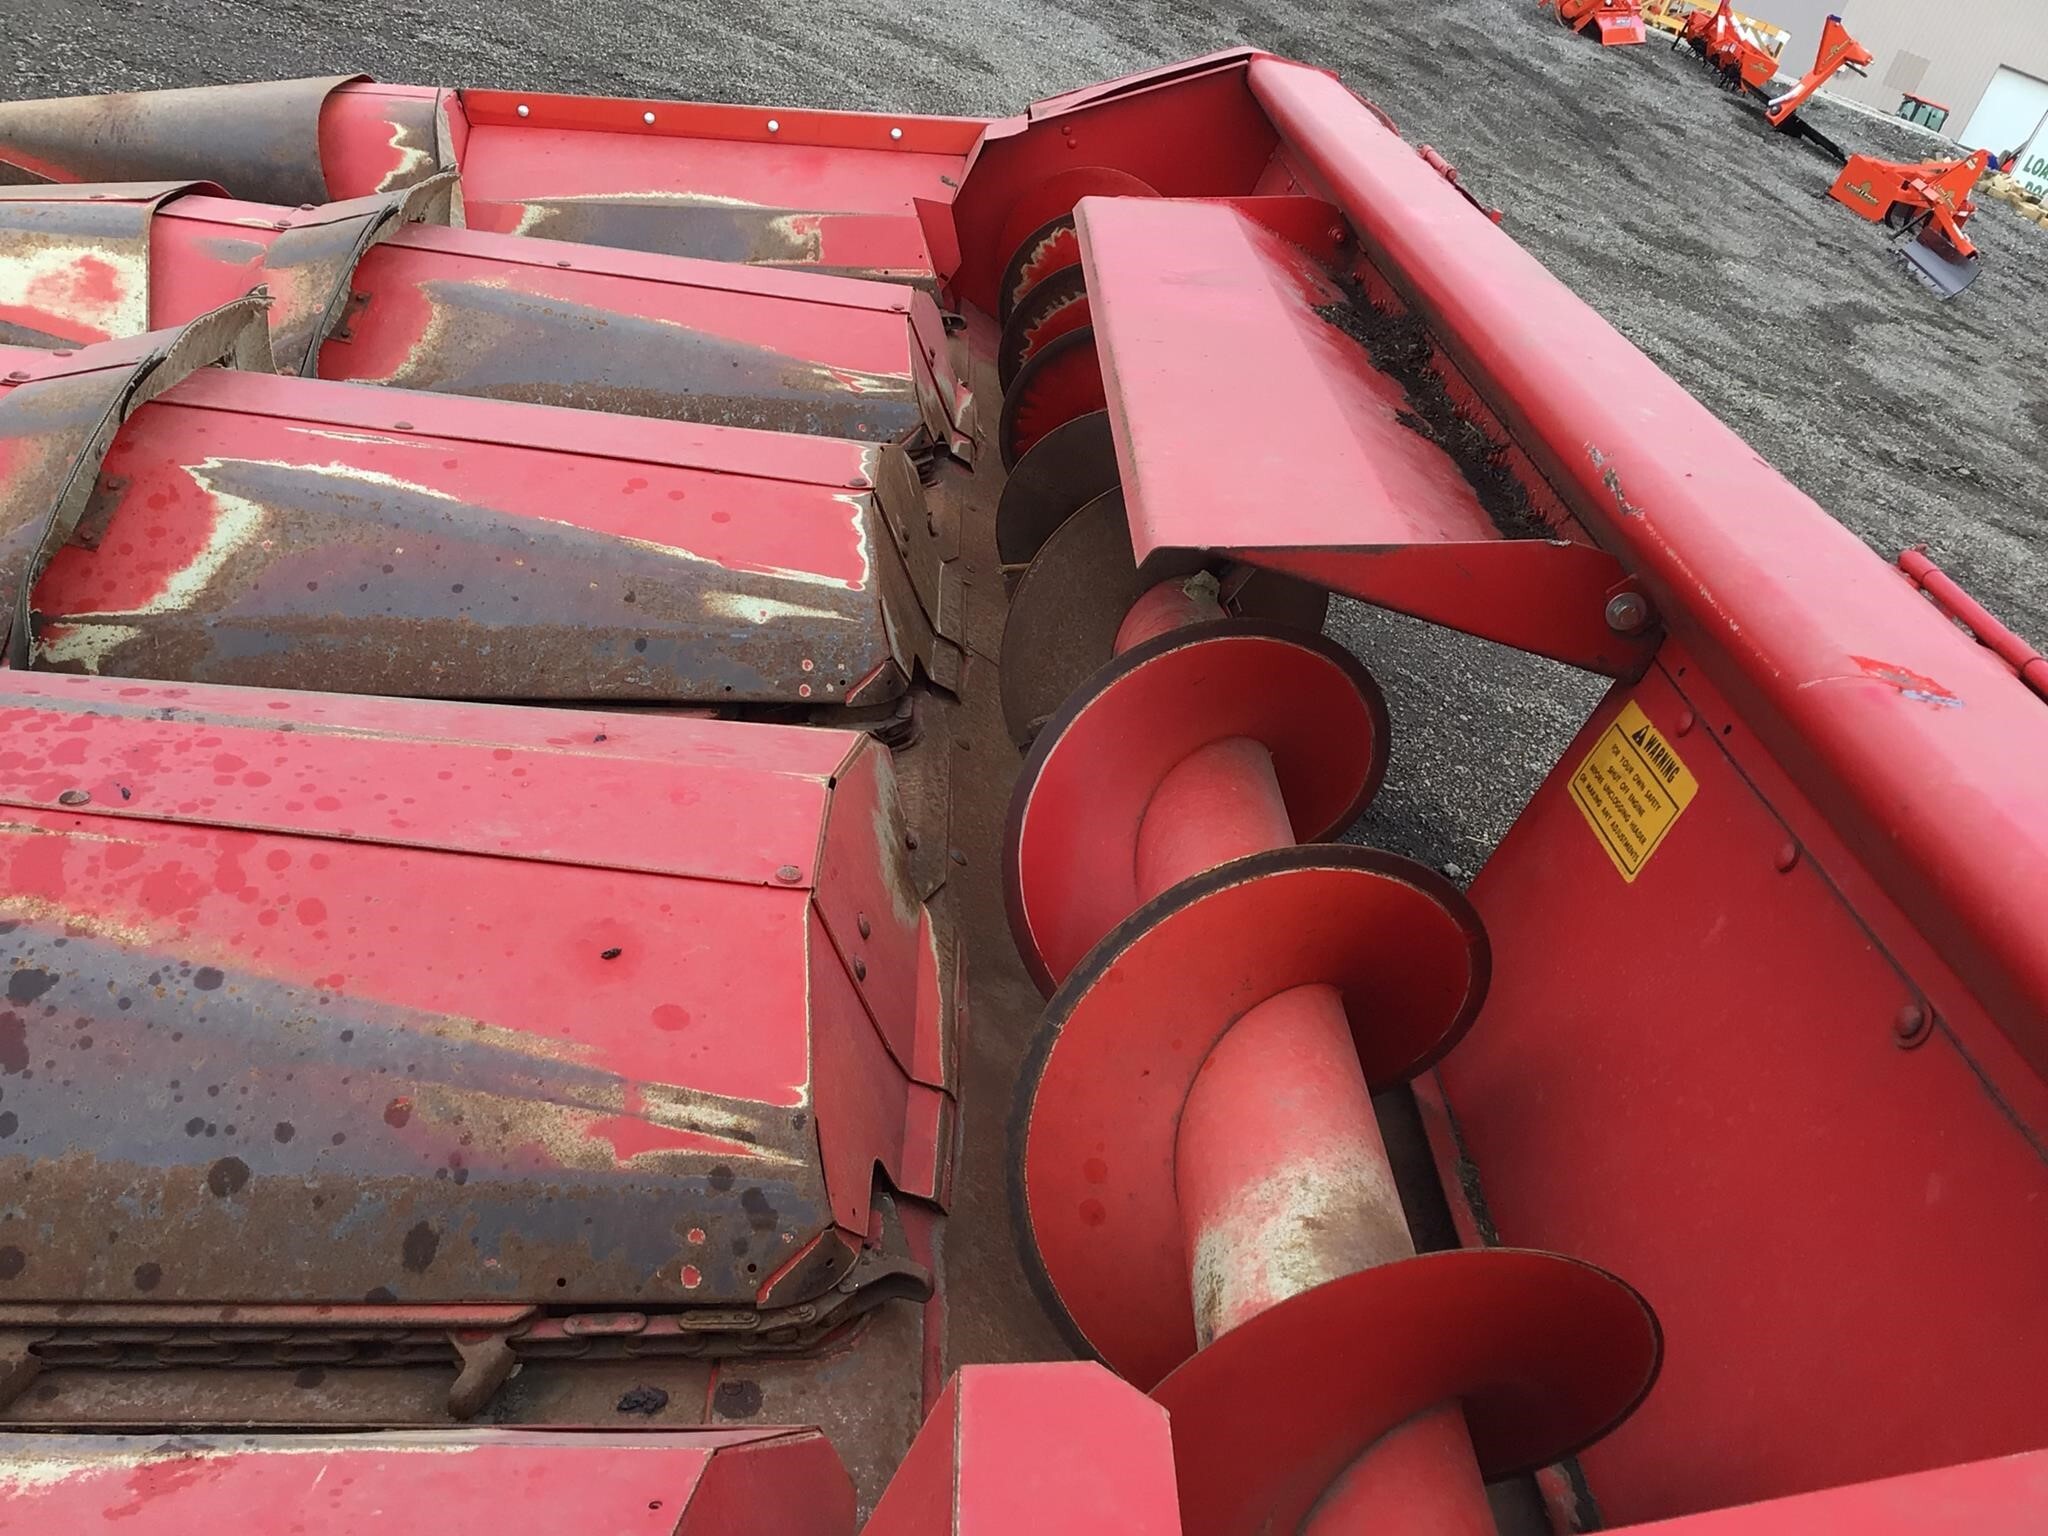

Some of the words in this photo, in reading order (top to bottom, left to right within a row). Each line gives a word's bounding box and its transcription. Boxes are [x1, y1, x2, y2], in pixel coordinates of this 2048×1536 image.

[2022, 154, 2048, 180] LOA
[1643, 734, 1680, 784] WARNING
[1607, 764, 1621, 784] SHUT
[1618, 780, 1629, 796] OFF
[1627, 792, 1645, 818] ENGINE
[1619, 754, 1634, 775] YOUR
[1632, 772, 1646, 792] OWN
[1644, 789, 1661, 813] SAFETY
[1601, 805, 1612, 821] ANY
[1628, 819, 1647, 846] HEADER
